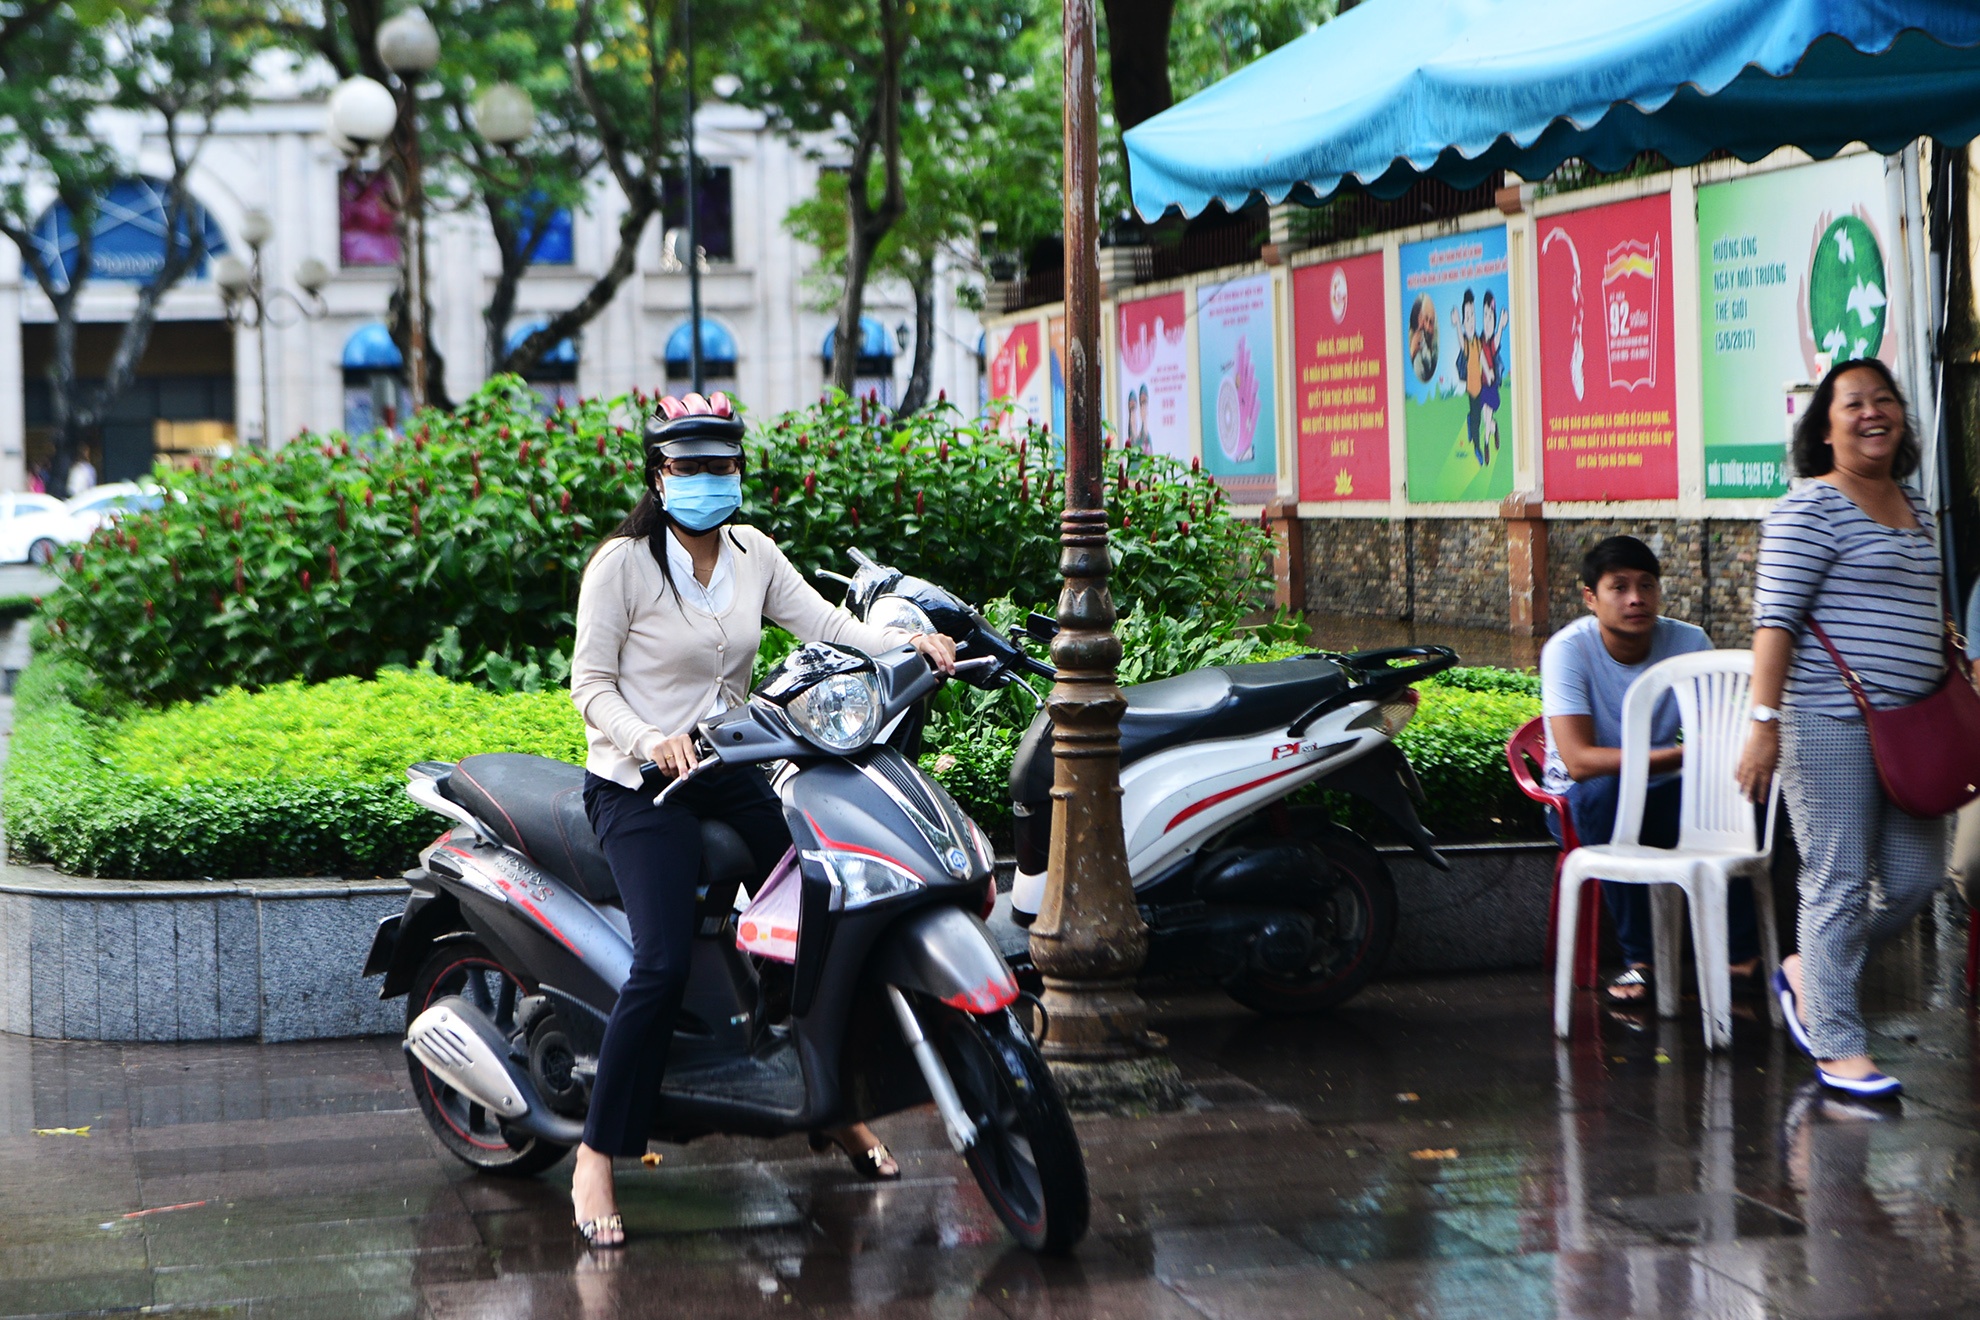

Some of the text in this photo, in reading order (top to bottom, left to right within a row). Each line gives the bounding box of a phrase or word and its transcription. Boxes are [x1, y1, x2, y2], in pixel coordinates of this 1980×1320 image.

[1737, 264, 1753, 288] MÔI
[1609, 300, 1630, 338] 92
[1715, 295, 1730, 321] THẾ
[1715, 327, 1756, 351] (5/6/2017)
